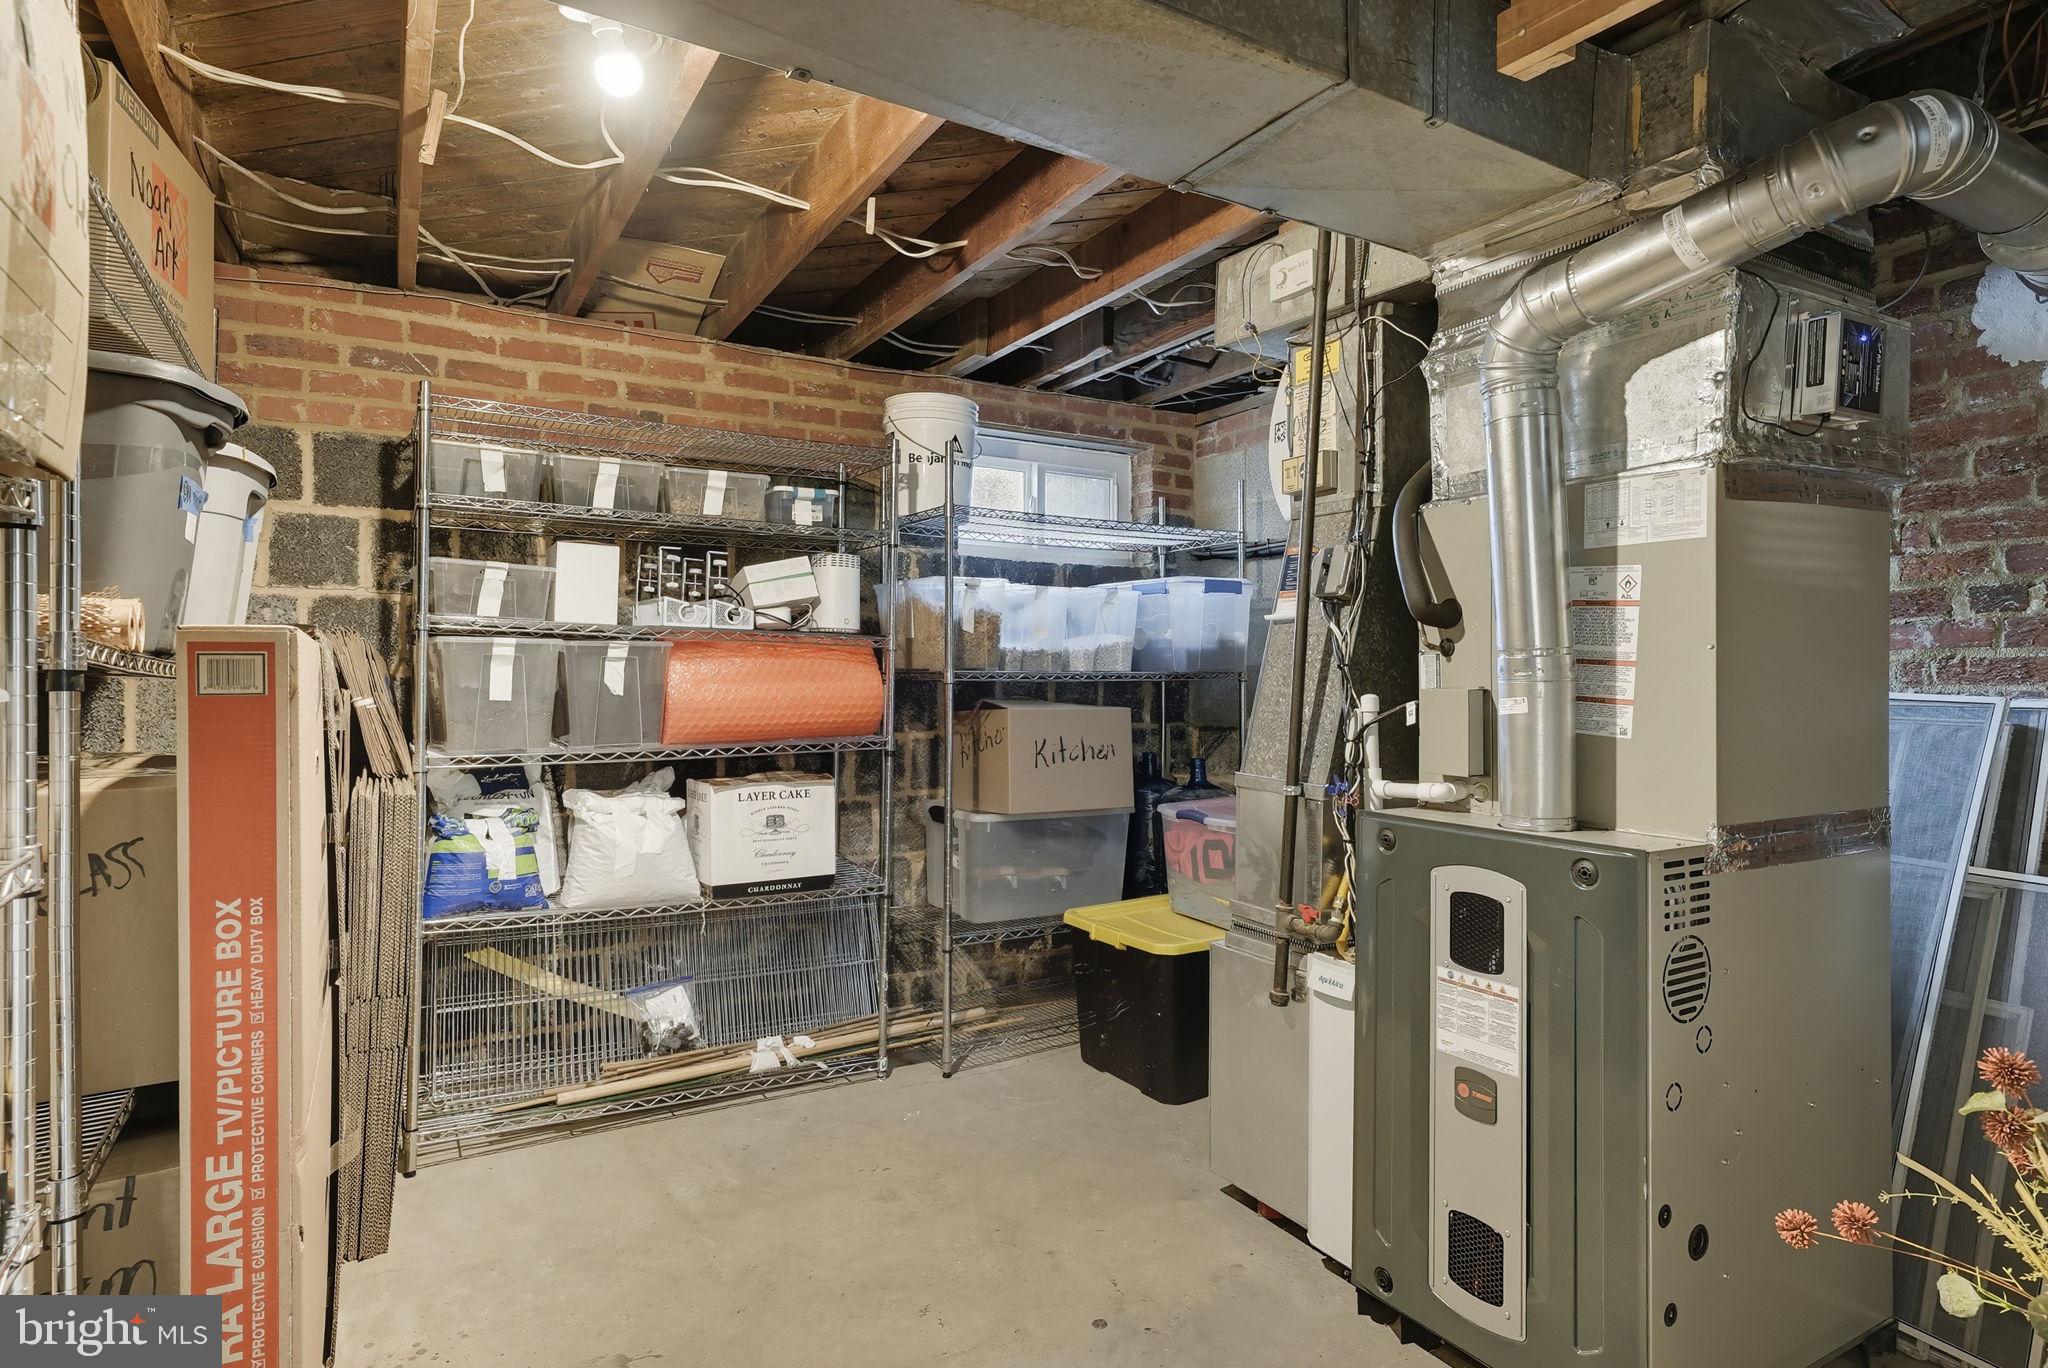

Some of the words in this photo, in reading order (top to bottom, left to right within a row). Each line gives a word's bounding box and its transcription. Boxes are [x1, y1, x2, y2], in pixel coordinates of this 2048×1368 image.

[119, 86, 157, 142] MEDIUM
[130, 151, 172, 231] Noah
[154, 227, 180, 280] Ark
[1035, 736, 1115, 768] Kitchen
[738, 791, 776, 802] LAYER
[779, 789, 811, 800] CAKE
[251, 897, 264, 925] BOX
[748, 883, 802, 894] CHARDONNAY
[215, 897, 243, 960] BOX
[251, 930, 264, 964] DUTY
[251, 969, 264, 1010] HEAVY
[216, 968, 243, 1146] TV/PICTURE
[251, 1030, 264, 1094] CORNERS
[251, 1096, 265, 1181] PROTECTIVE
[205, 1151, 244, 1296] LARGE
[252, 1206, 265, 1269] CUSHION
[252, 1271, 266, 1359] PROTECTIVE
